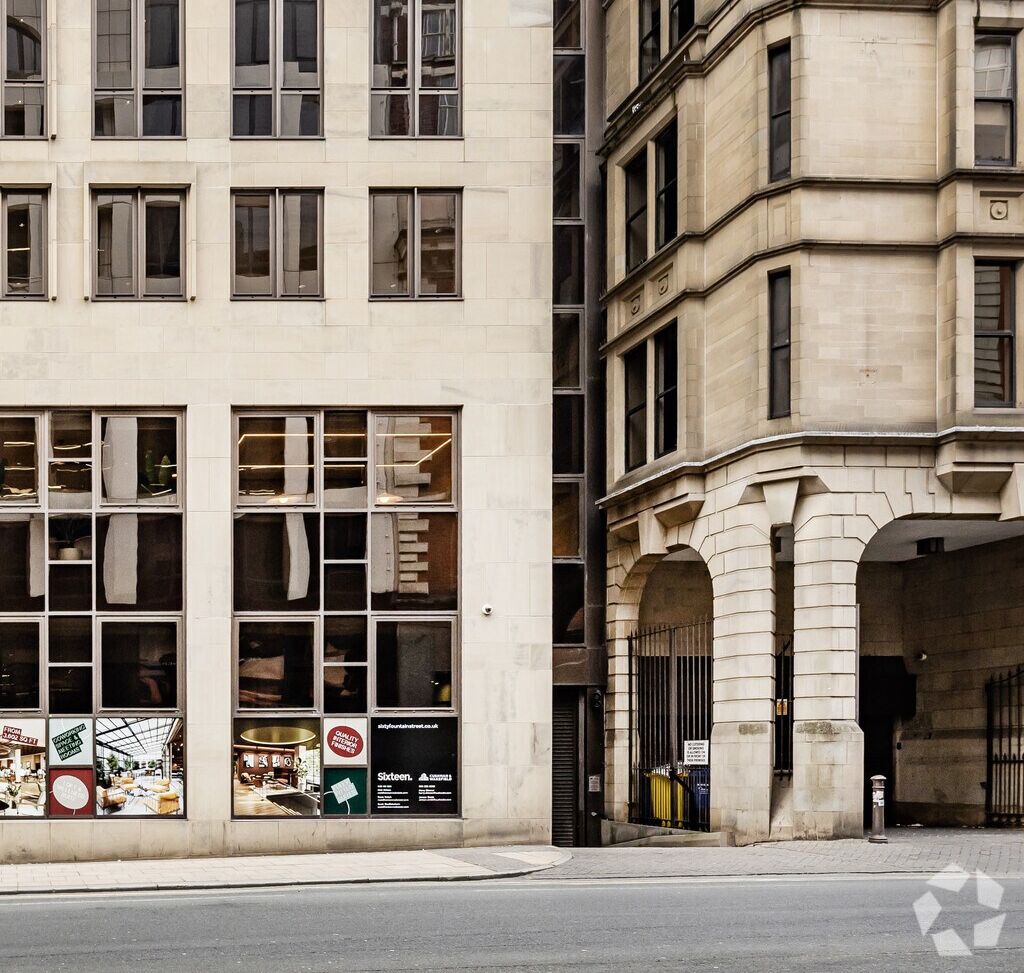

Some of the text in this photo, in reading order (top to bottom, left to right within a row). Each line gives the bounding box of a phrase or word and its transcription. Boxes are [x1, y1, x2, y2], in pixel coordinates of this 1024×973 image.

[4, 726, 21, 735] FROM
[336, 730, 359, 743] QUALITY
[56, 737, 73, 749] SPACE
[58, 740, 82, 755] MEETING
[331, 740, 356, 754] FINISHES
[332, 735, 358, 749] INTERIOR
[60, 747, 80, 759] ROOMS
[377, 772, 413, 781] Sixteen.
